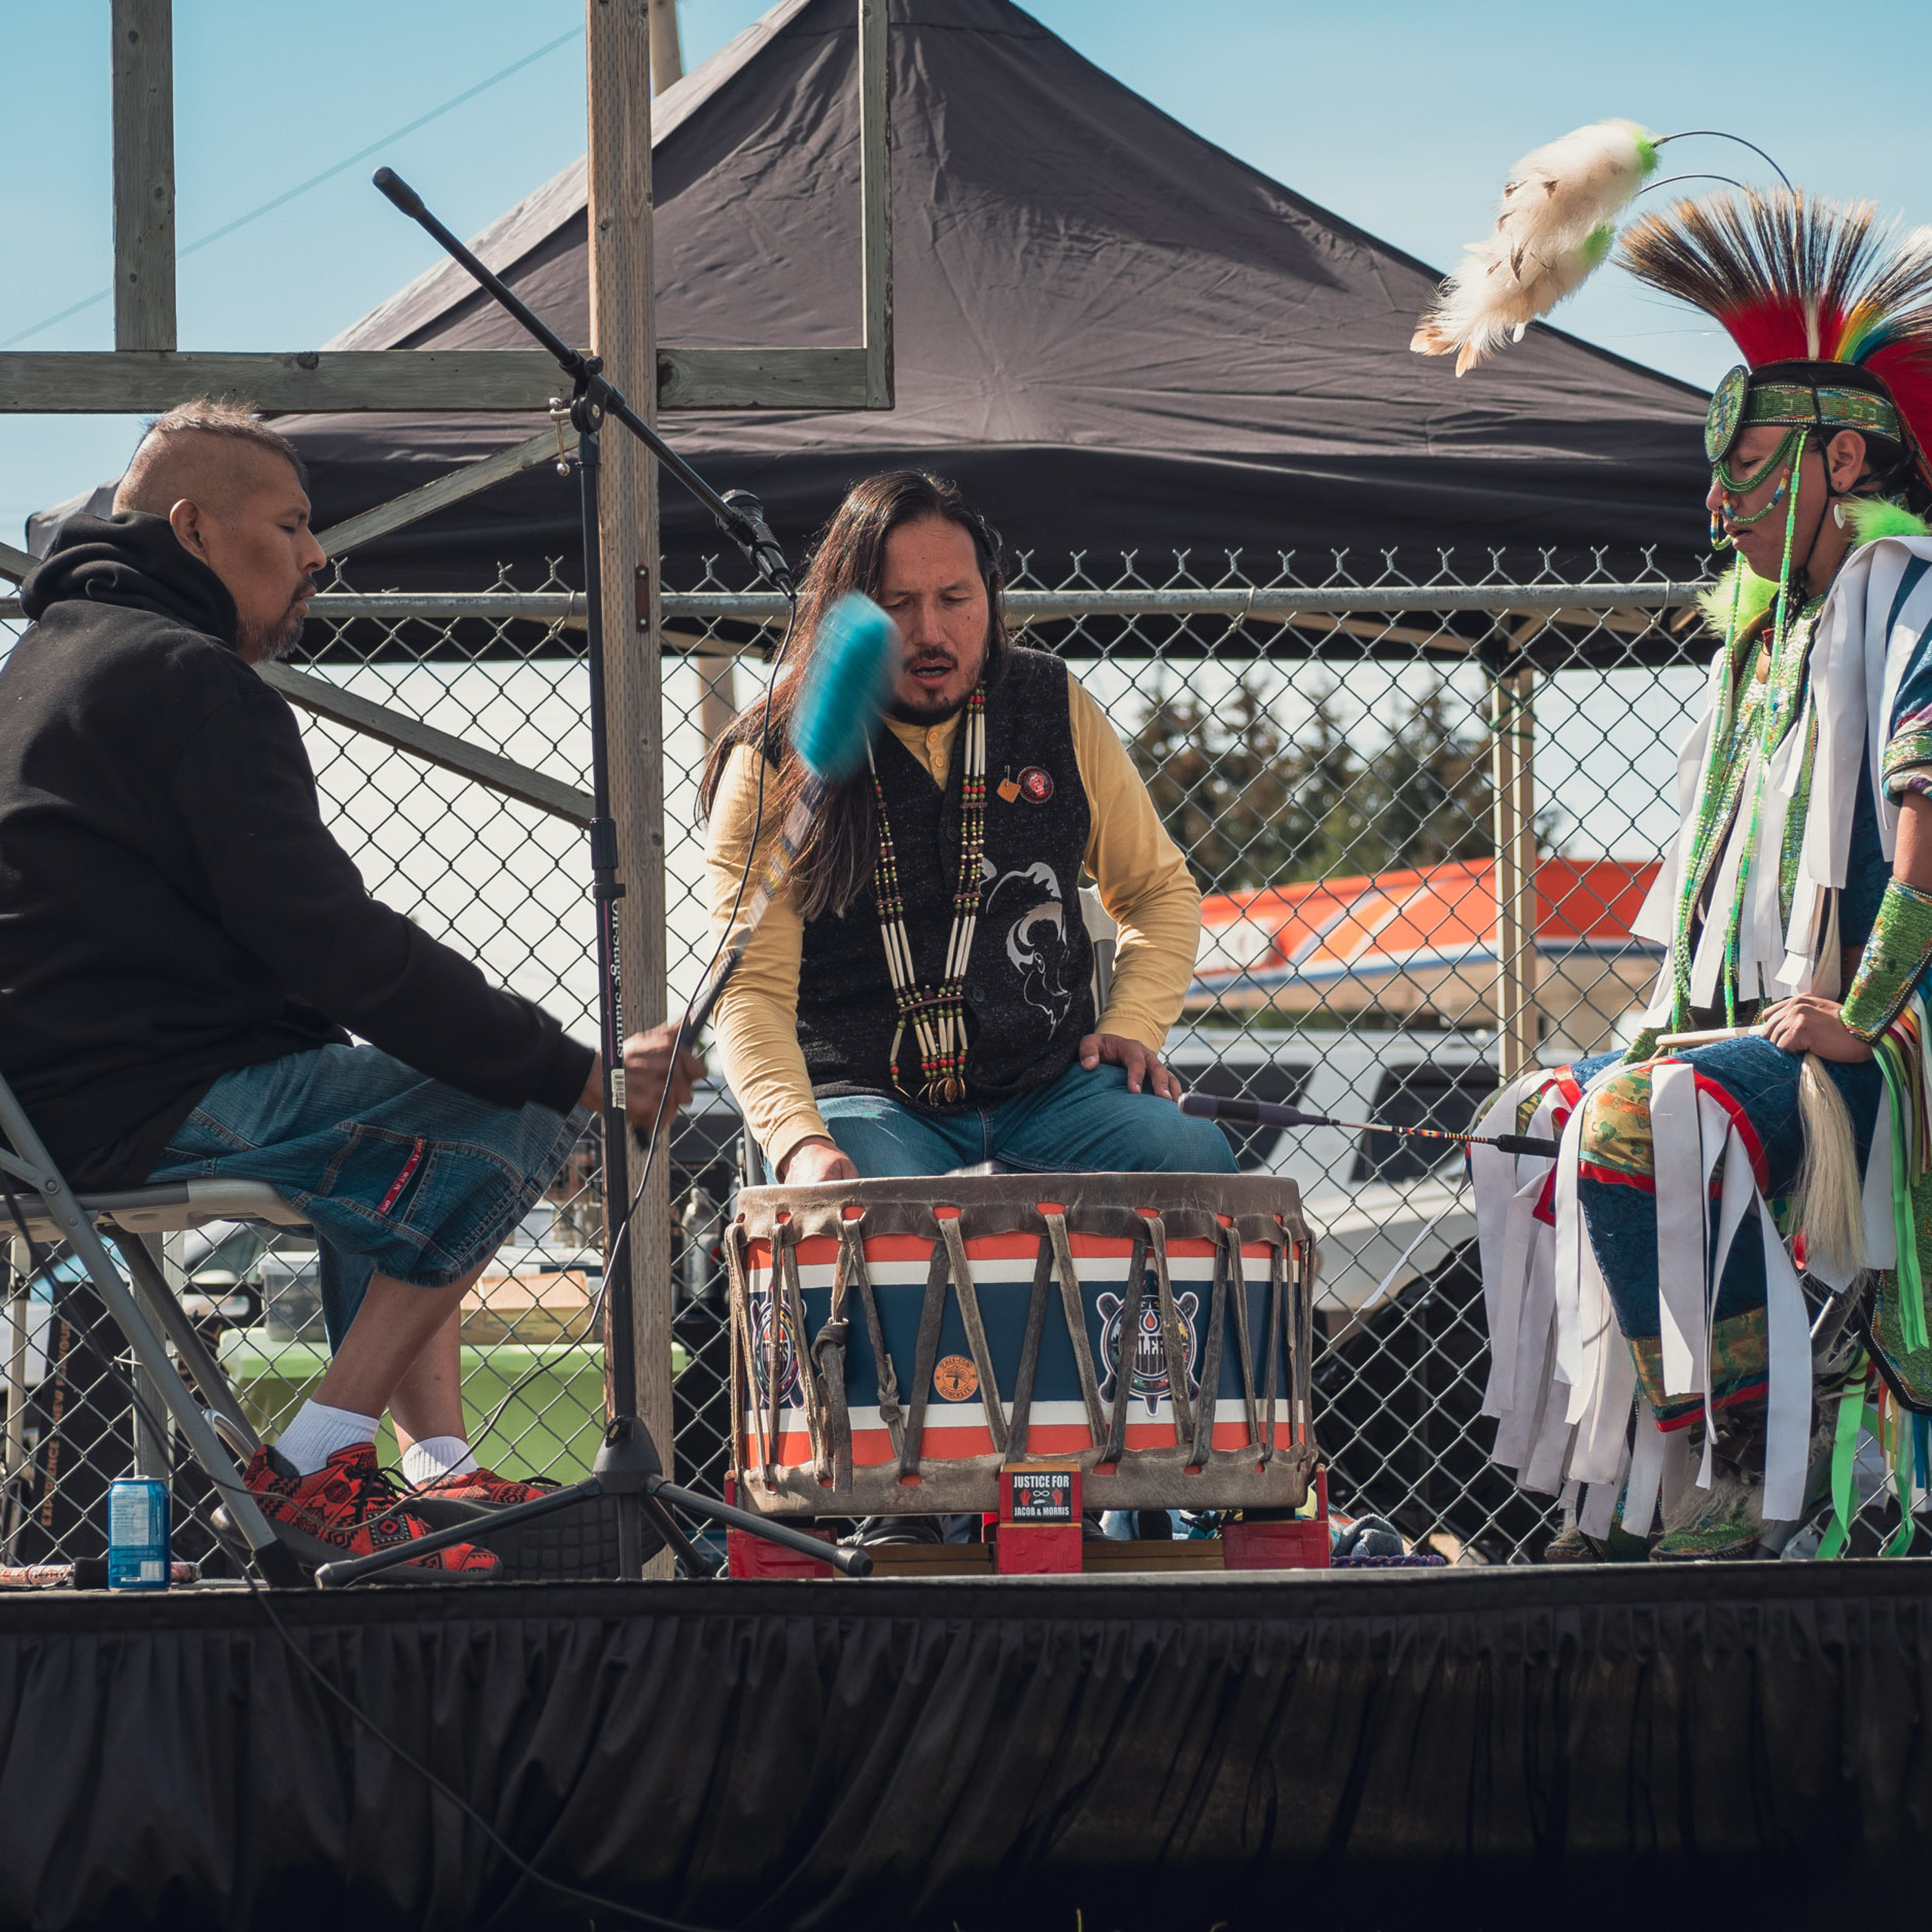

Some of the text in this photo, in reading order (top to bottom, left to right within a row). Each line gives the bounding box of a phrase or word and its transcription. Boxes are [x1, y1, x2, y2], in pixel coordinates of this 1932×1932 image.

[41, 1440, 60, 1527] EXPERIENCE
[1014, 1475, 1069, 1488] JUSTICE FOR
[1014, 1507, 1069, 1516] JACOB & MORRIS
